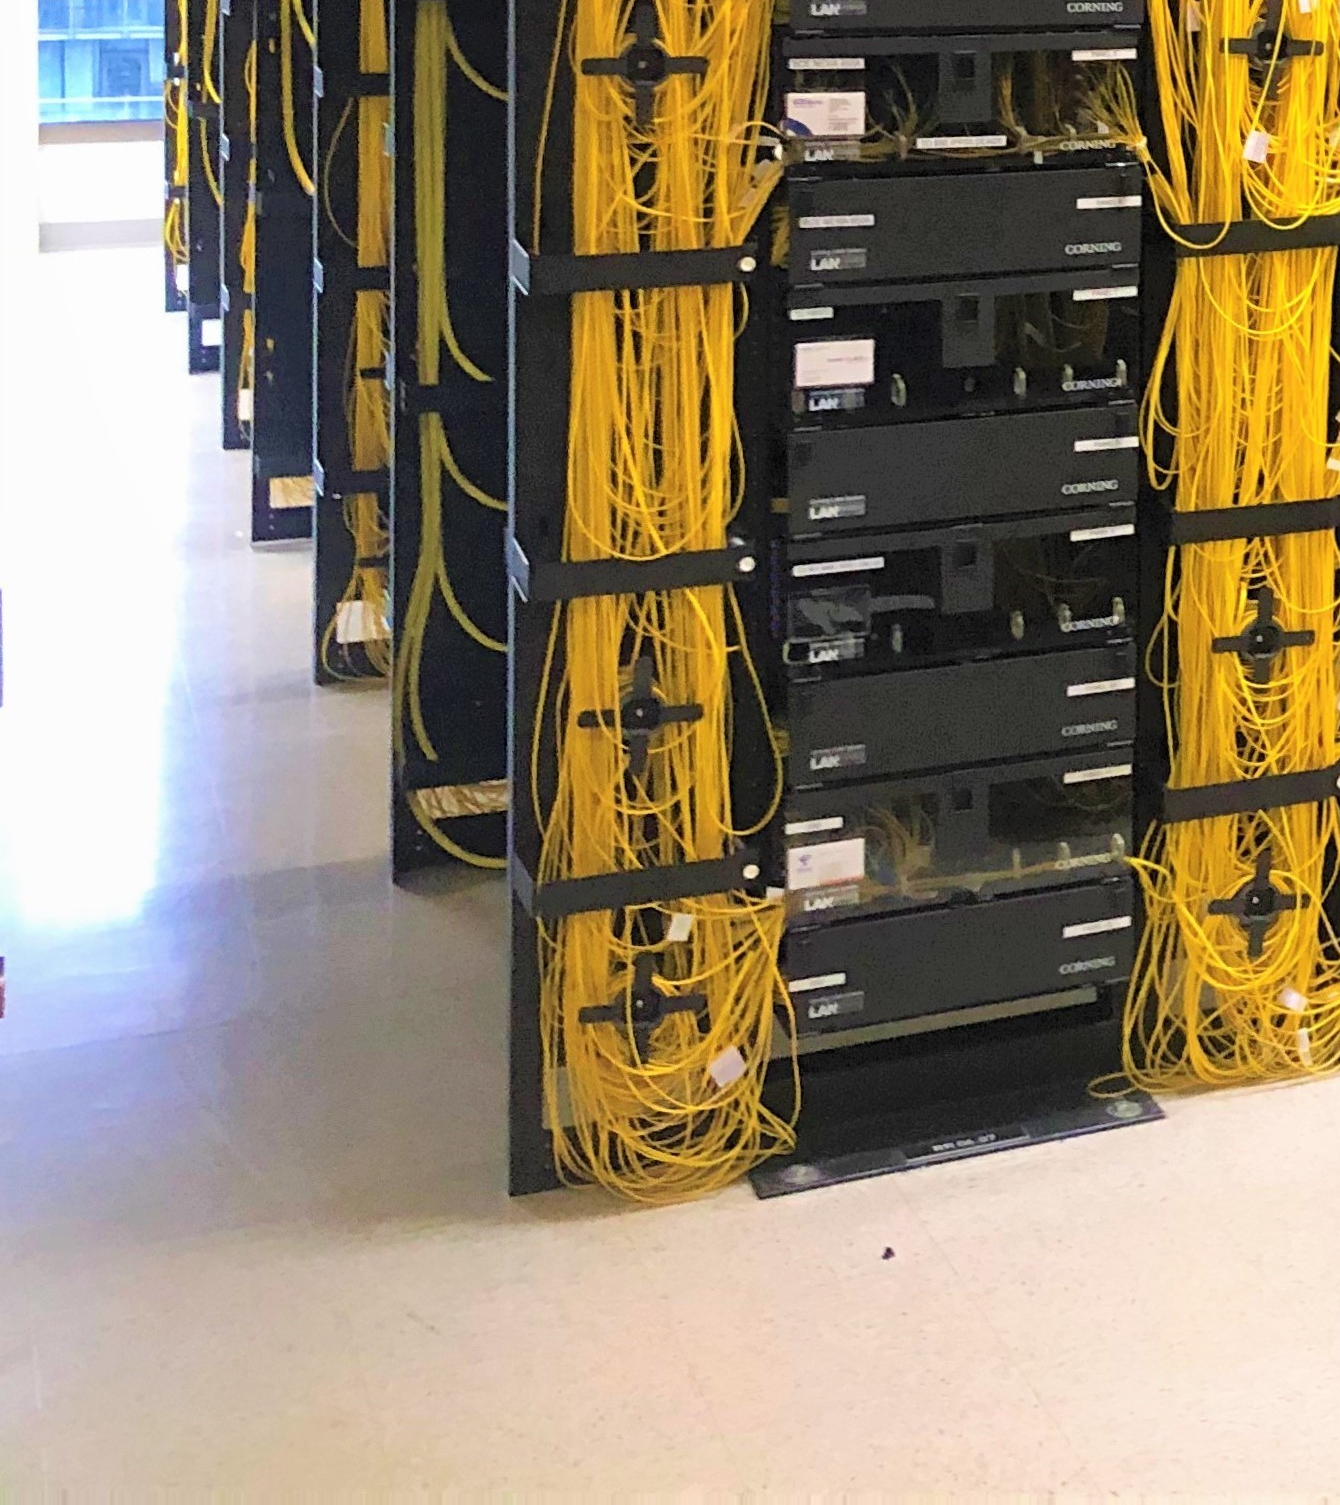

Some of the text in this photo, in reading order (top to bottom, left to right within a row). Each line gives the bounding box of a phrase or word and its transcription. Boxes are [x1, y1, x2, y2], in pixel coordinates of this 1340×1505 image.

[1066, 1, 1123, 13] CORNING
[1064, 241, 1121, 255] CORNING
[1061, 377, 1121, 392] CORNING
[1060, 479, 1119, 495] CORNING
[1061, 719, 1118, 737] CORNING
[1058, 955, 1115, 975] CORNING
